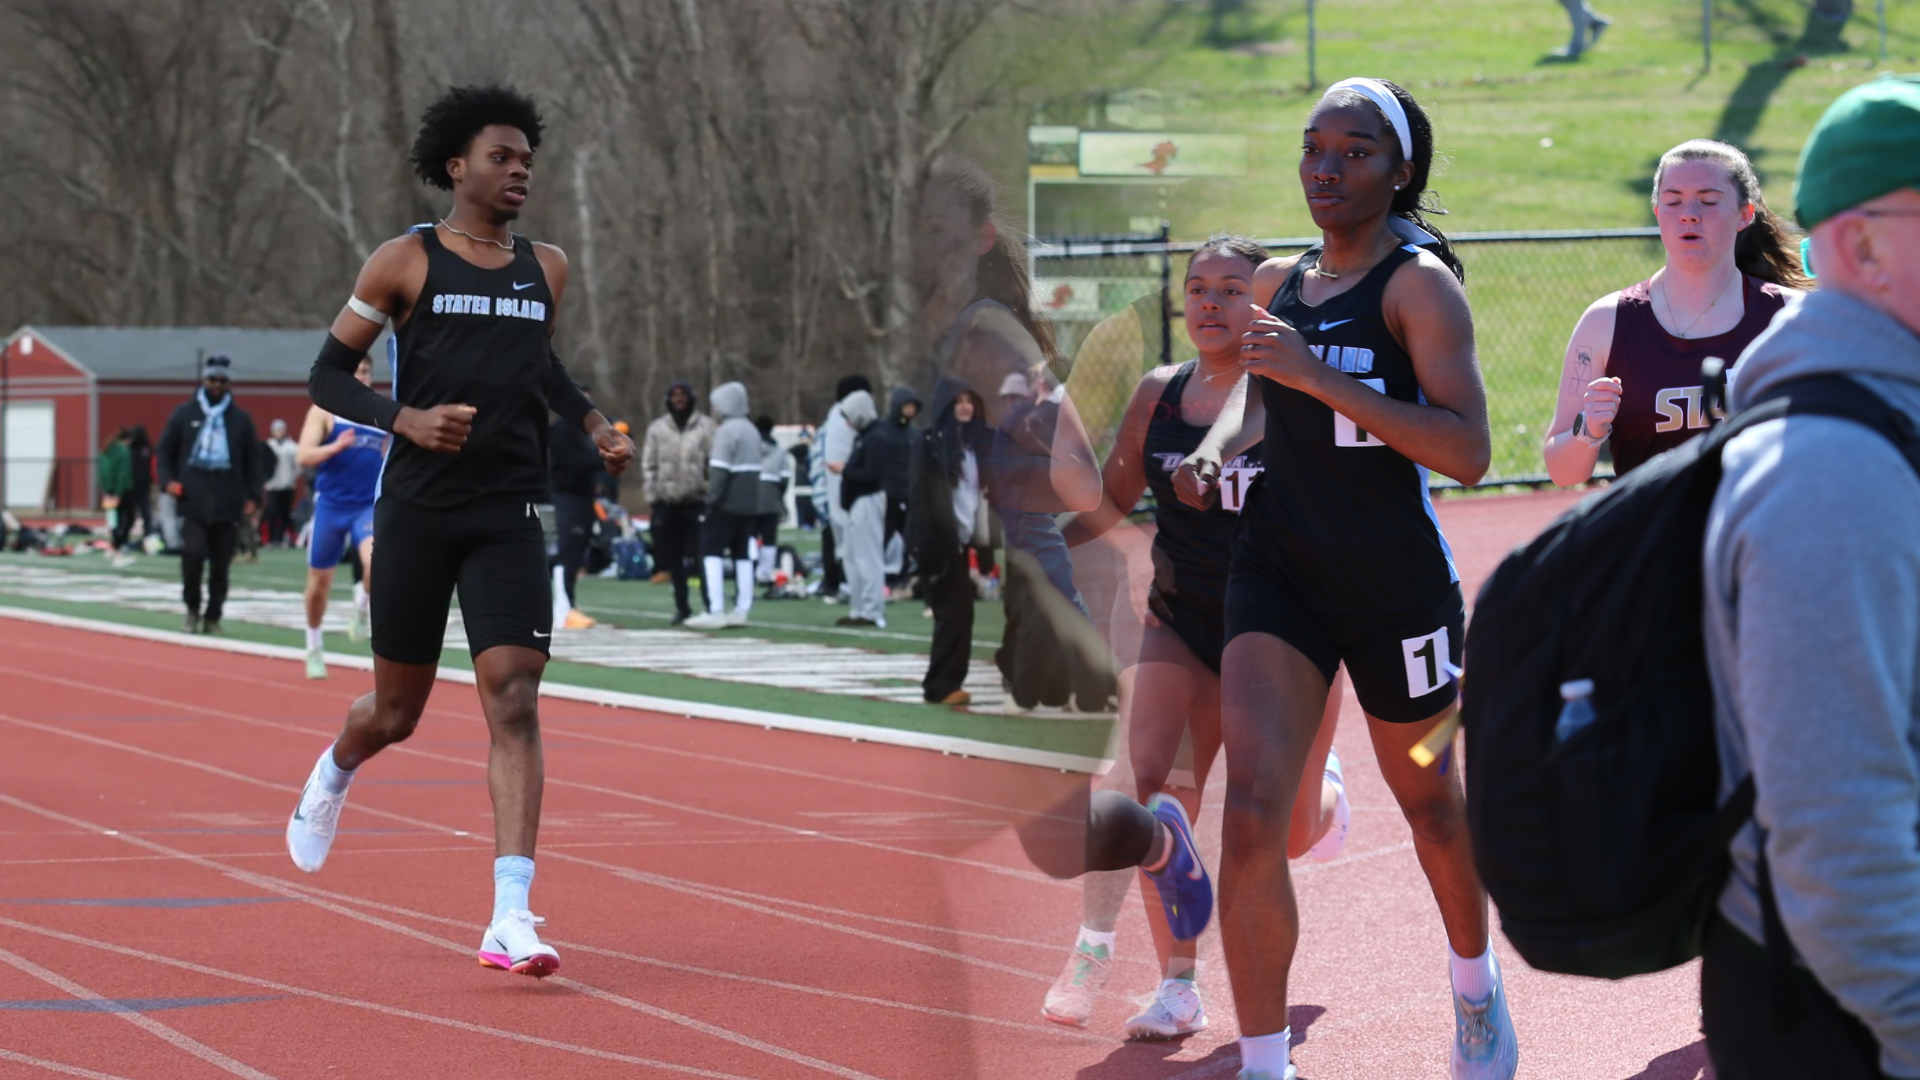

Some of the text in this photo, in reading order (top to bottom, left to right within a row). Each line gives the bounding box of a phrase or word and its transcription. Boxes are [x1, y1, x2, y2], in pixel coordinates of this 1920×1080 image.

[432, 294, 545, 321] STATEN ISLAND
[1655, 385, 1727, 433] STA
[1413, 638, 1438, 689] 1
